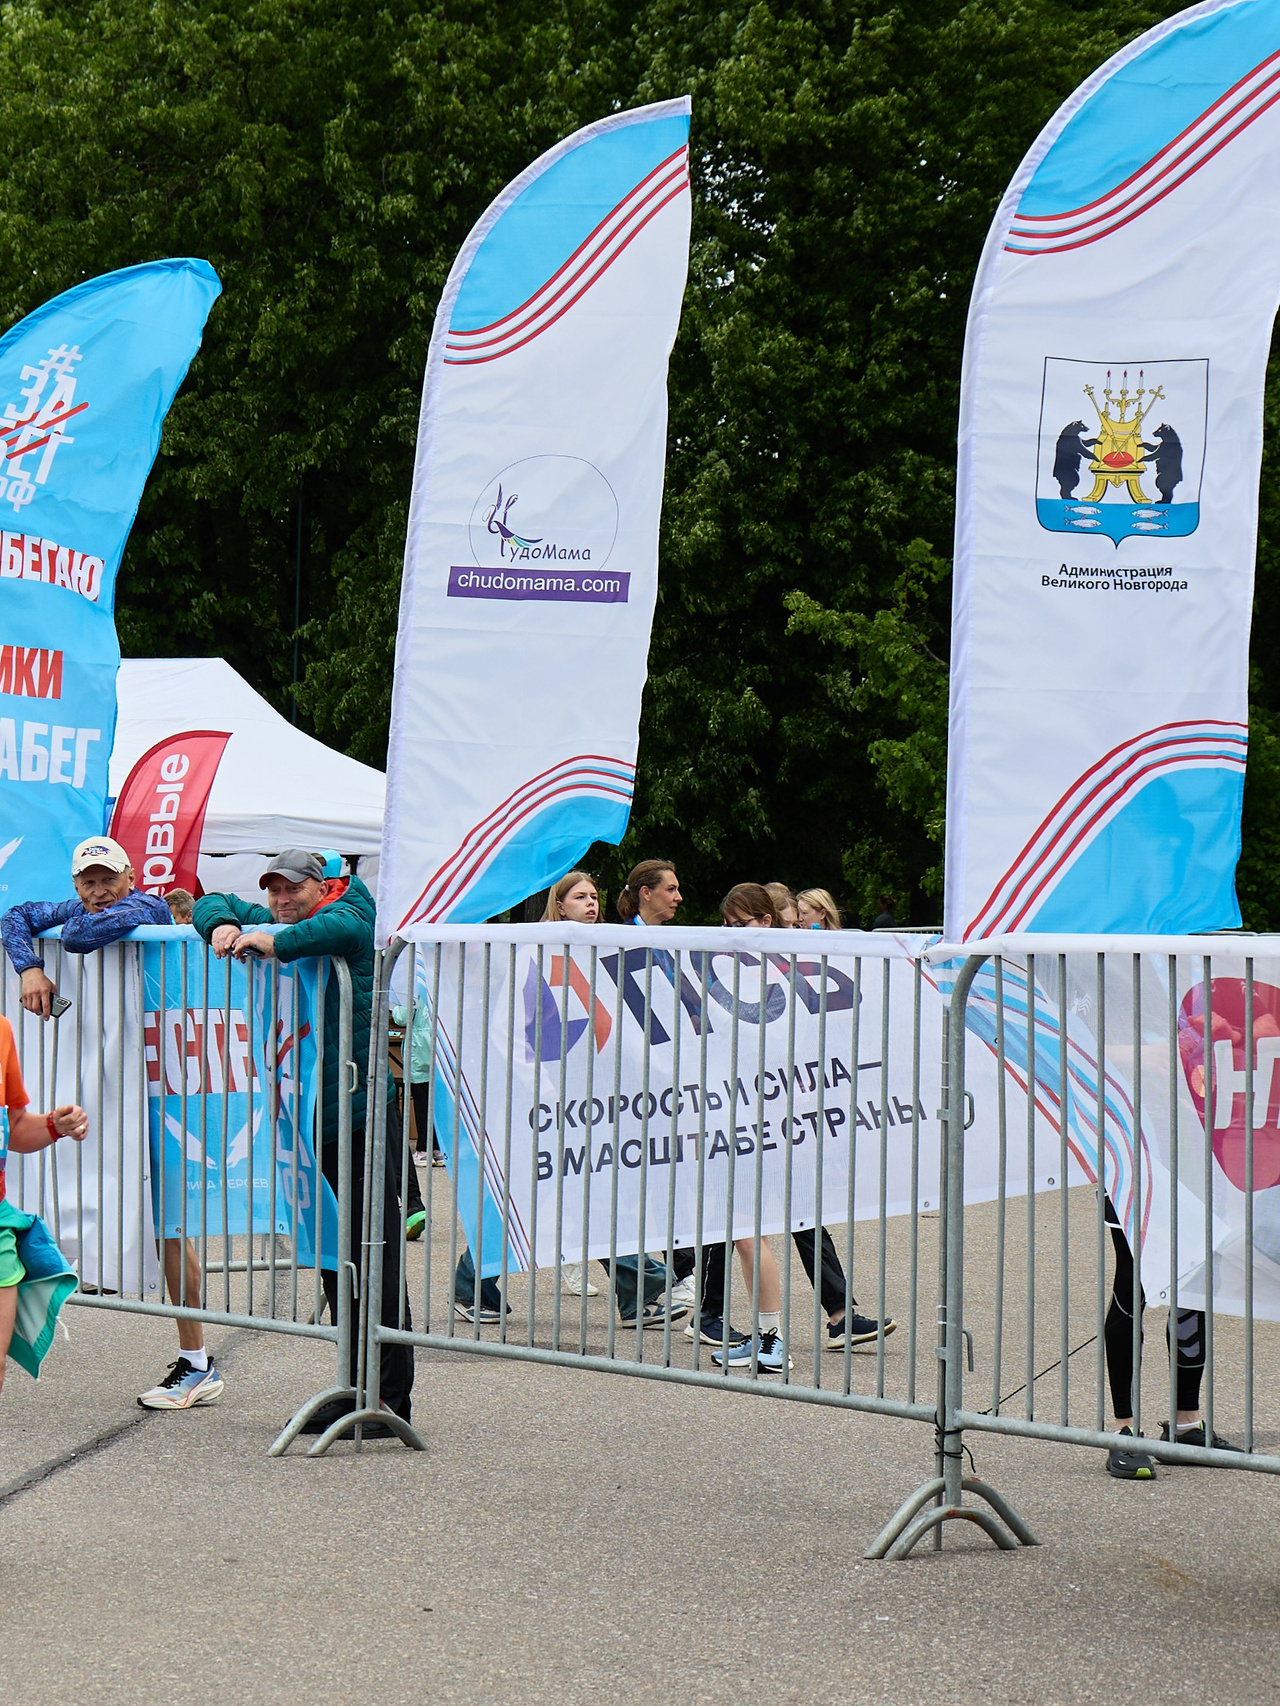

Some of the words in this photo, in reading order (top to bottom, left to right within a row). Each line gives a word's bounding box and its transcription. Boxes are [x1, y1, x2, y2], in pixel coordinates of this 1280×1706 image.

[457, 571, 620, 593] chudomama.com
[1058, 563, 1173, 580] Администрация
[1041, 575, 1110, 591] Великого
[1113, 578, 1188, 593] Новгорода
[528, 1083, 723, 1132] СКОРОСТЬ
[563, 1120, 777, 1176] МАСШТАБЕ
[781, 1096, 927, 1145] СТРАНЫ
